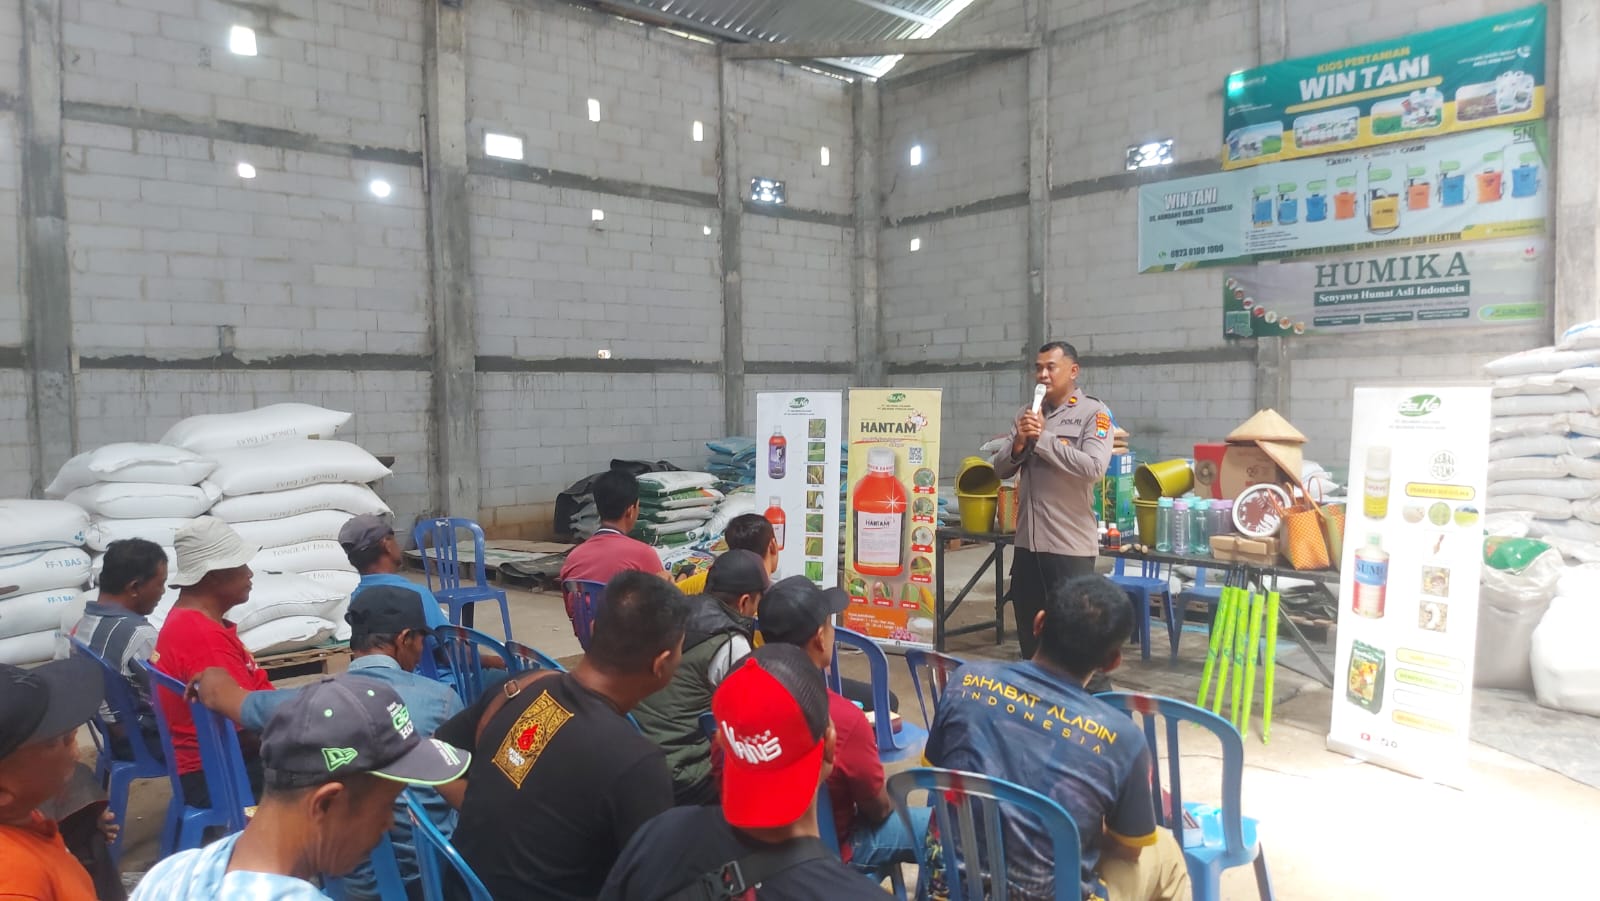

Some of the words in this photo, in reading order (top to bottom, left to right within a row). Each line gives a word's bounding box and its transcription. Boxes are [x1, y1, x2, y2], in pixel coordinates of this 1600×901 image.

[1317, 61, 1343, 73] KIOS
[1344, 46, 1411, 67] PERTANIAN
[1299, 70, 1355, 101] WIN
[1361, 54, 1429, 88] TANI
[1164, 191, 1188, 211] WIN
[1191, 187, 1217, 207] TANI
[1314, 252, 1470, 288] HUMIKA
[1319, 292, 1358, 304] Senyawa
[1361, 289, 1393, 299] Humat
[1395, 286, 1414, 297] Asli
[1417, 284, 1465, 295] Indonesia
[860, 421, 917, 434] HANTAM
[961, 689, 1103, 756] INDONESIA
[963, 673, 1041, 708] SAHABAT
[1047, 705, 1118, 745] ALADIN
